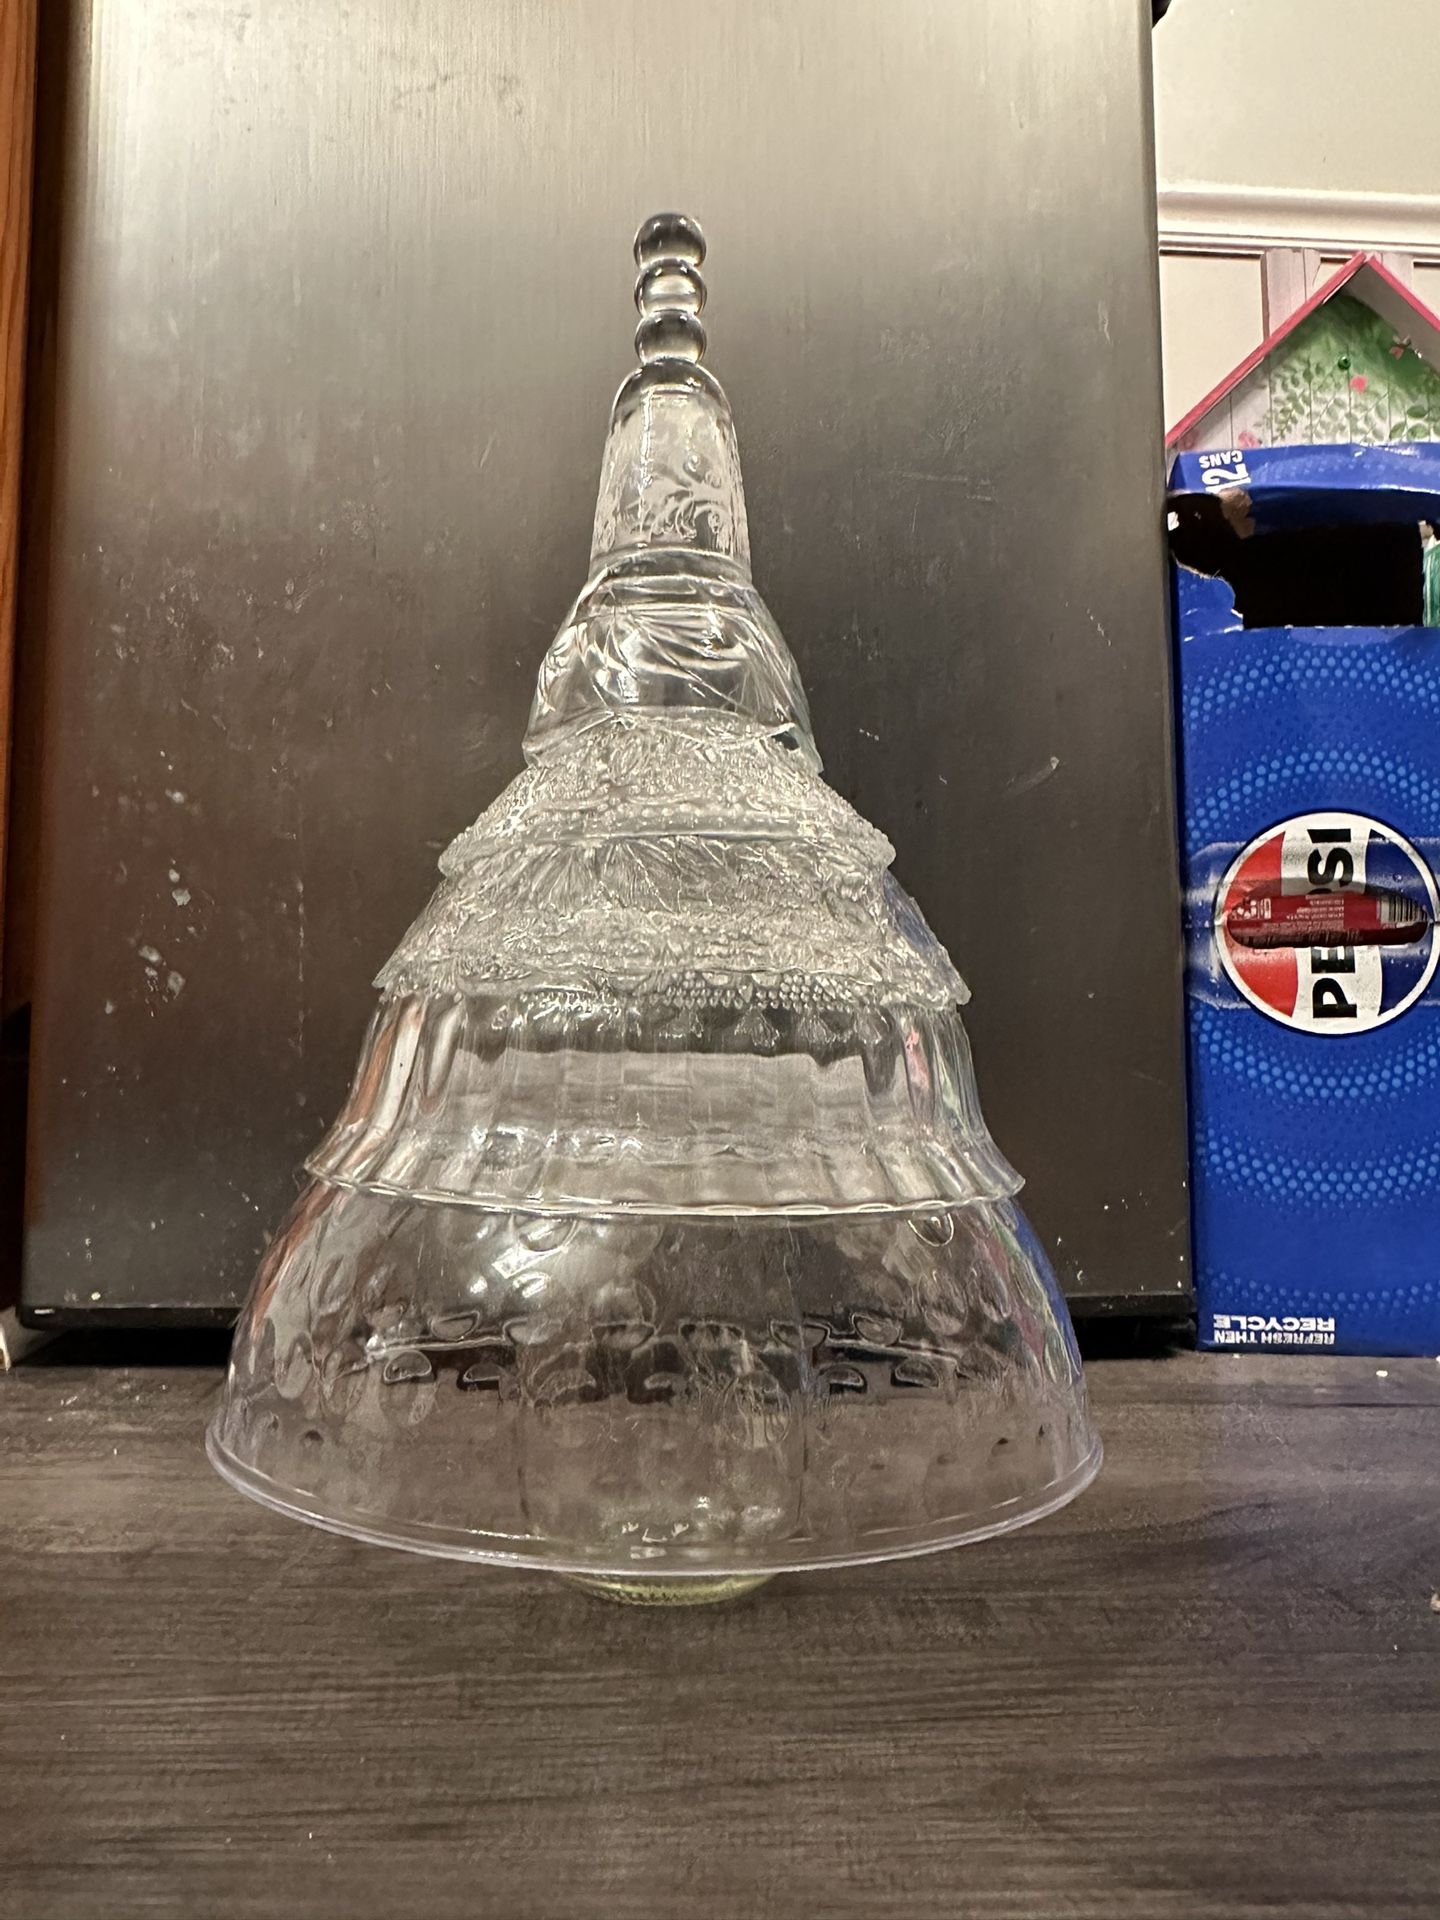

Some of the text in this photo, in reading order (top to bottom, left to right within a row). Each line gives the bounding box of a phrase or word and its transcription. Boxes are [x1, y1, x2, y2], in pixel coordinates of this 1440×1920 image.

[1199, 450, 1243, 469] CANS
[1202, 463, 1251, 493] 12
[1307, 828, 1357, 1018] PESI
[1213, 1314, 1335, 1332] RECYCLE
[1214, 1330, 1335, 1345] REFRESH THEN
